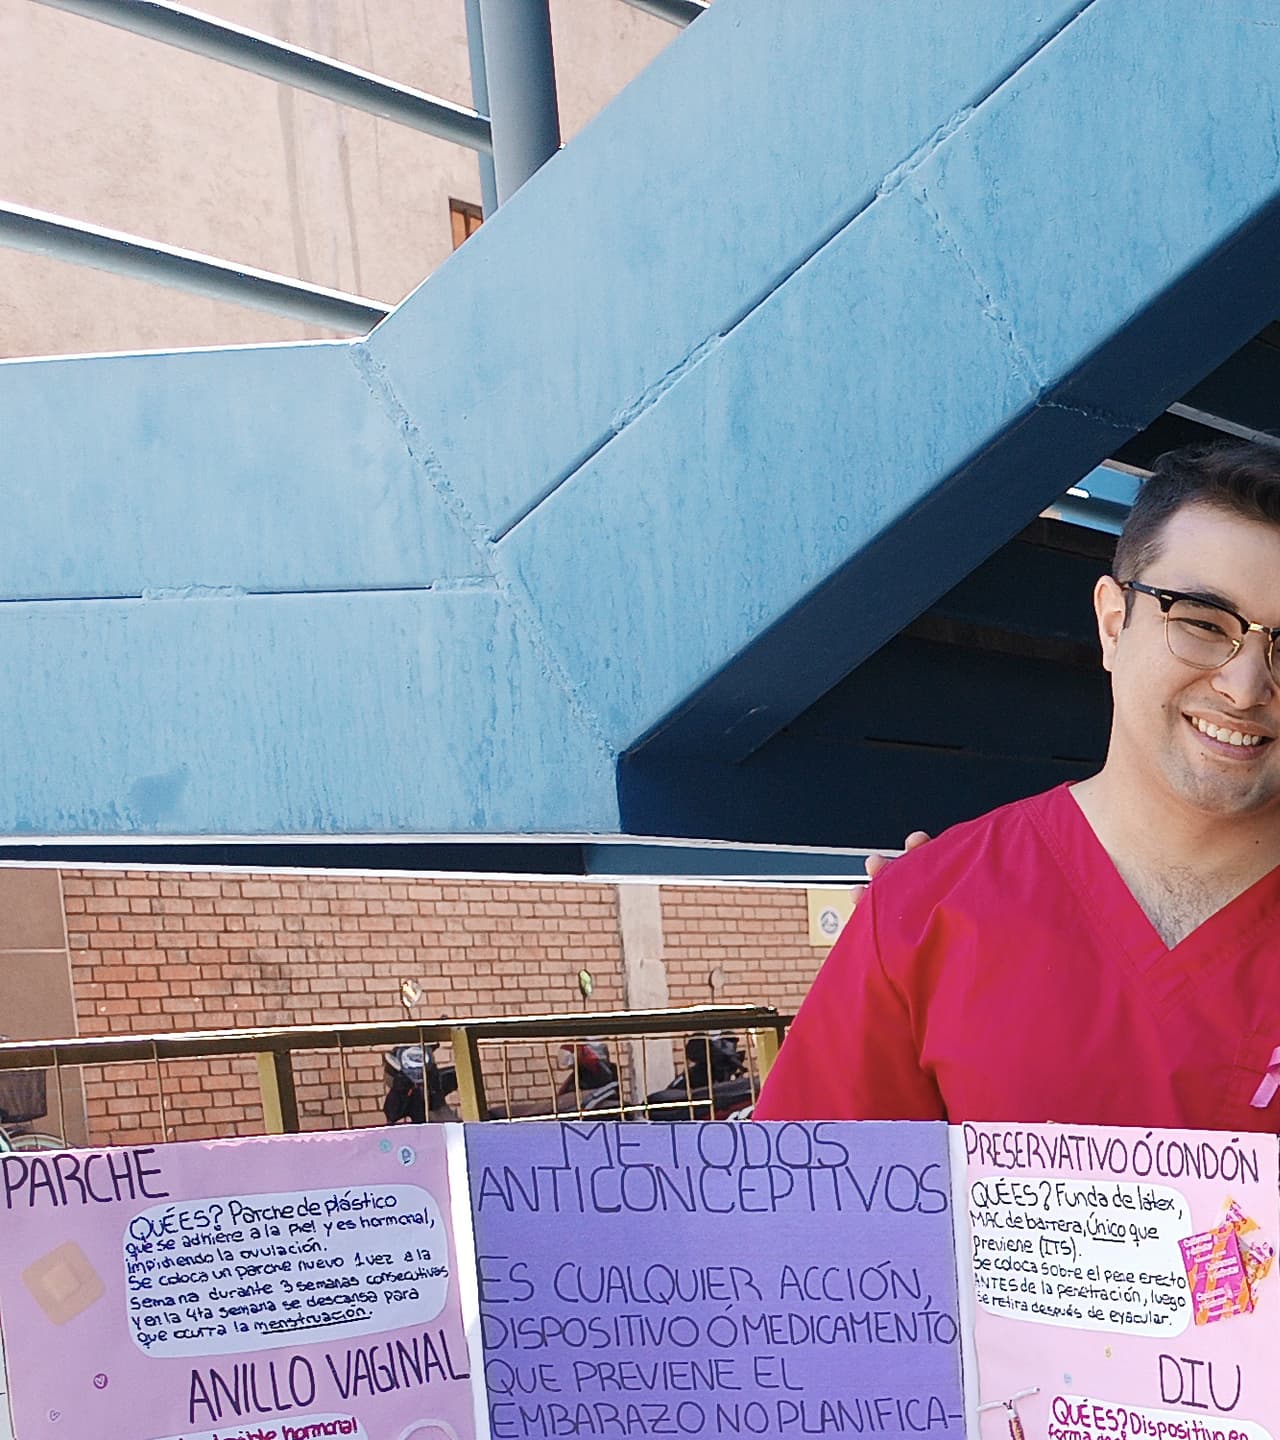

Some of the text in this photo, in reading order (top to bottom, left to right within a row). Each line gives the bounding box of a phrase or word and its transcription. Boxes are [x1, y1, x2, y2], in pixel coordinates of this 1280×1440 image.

[963, 1124, 1259, 1184] PRESERVATIVO Ó CONDÓN
[2, 1149, 169, 1208] PARCHE
[477, 1164, 951, 1214] ANTICONCEPTIVOS
[1055, 1182, 1109, 1208] Funda
[1112, 1183, 1136, 1210] de
[229, 1190, 397, 1225] Parche de plástico
[126, 1219, 356, 1261] que se adhiere a la piel y es
[969, 1210, 1160, 1247] MAC de que
[159, 1249, 431, 1286] coloca un nuevo la
[217, 1248, 234, 1261] la
[994, 1256, 1186, 1288] coloca el erecto
[209, 1281, 273, 1301] durante
[280, 1280, 293, 1294] 3
[477, 1255, 933, 1309] ES CUALQUIER ACCIÓN,
[1020, 1277, 1186, 1312] de la luego
[163, 1311, 182, 1325] la
[186, 1307, 214, 1322] 4ta
[282, 1299, 301, 1310] se
[384, 1288, 419, 1305] para
[992, 1296, 1028, 1311] retira
[1087, 1305, 1105, 1320] de
[137, 1330, 168, 1349] que
[233, 1321, 250, 1333] la
[482, 1313, 699, 1350] DISPOSITIVO
[743, 1308, 959, 1346] MEDICAMENTO
[189, 1329, 471, 1424] ANILLO VAGINAL
[484, 1356, 805, 1396] QUE PREVIENE EL
[1158, 1354, 1241, 1412] DIU
[491, 1400, 704, 1439] EMBARAZO
[717, 1400, 770, 1434] NO
